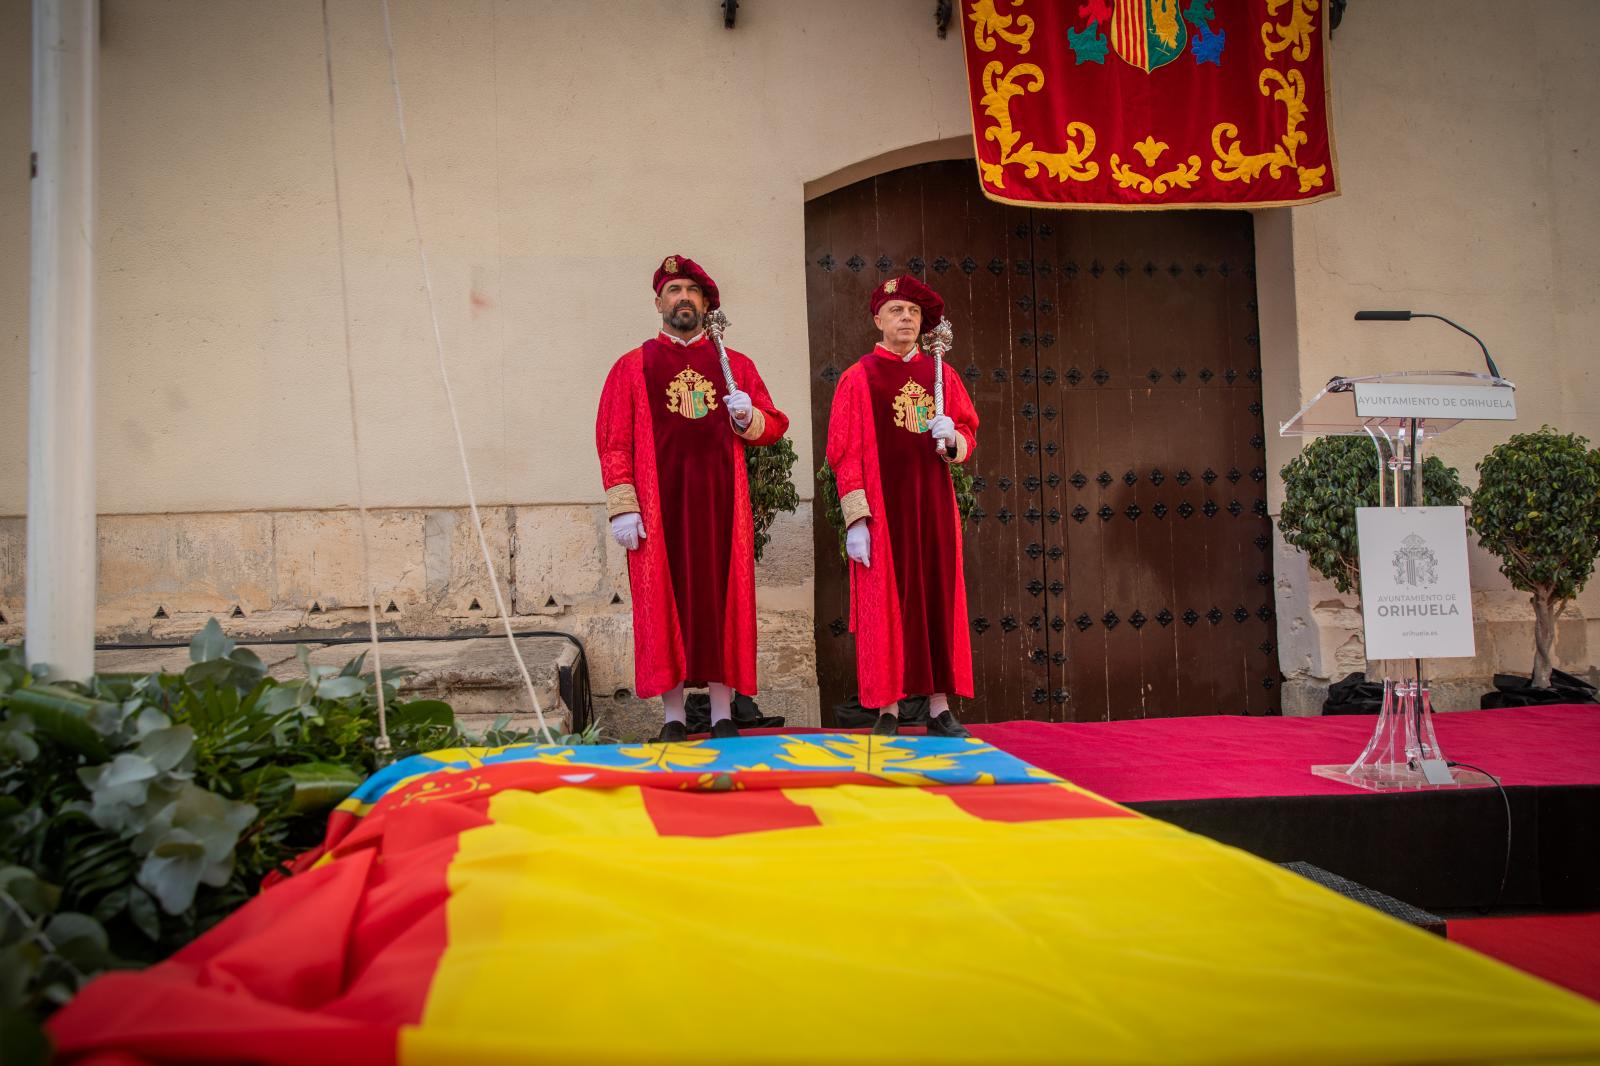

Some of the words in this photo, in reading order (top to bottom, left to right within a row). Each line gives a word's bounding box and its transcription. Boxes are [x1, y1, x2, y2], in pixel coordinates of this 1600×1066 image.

[1357, 395, 1440, 407] AYUNTAMIENTO
[1443, 398, 1456, 407] DE
[1460, 398, 1513, 408] ORIHUELA
[1378, 594, 1443, 602] AYUNTAMIENTO
[1445, 593, 1457, 601] DE
[1377, 604, 1460, 617] ORIHUELA
